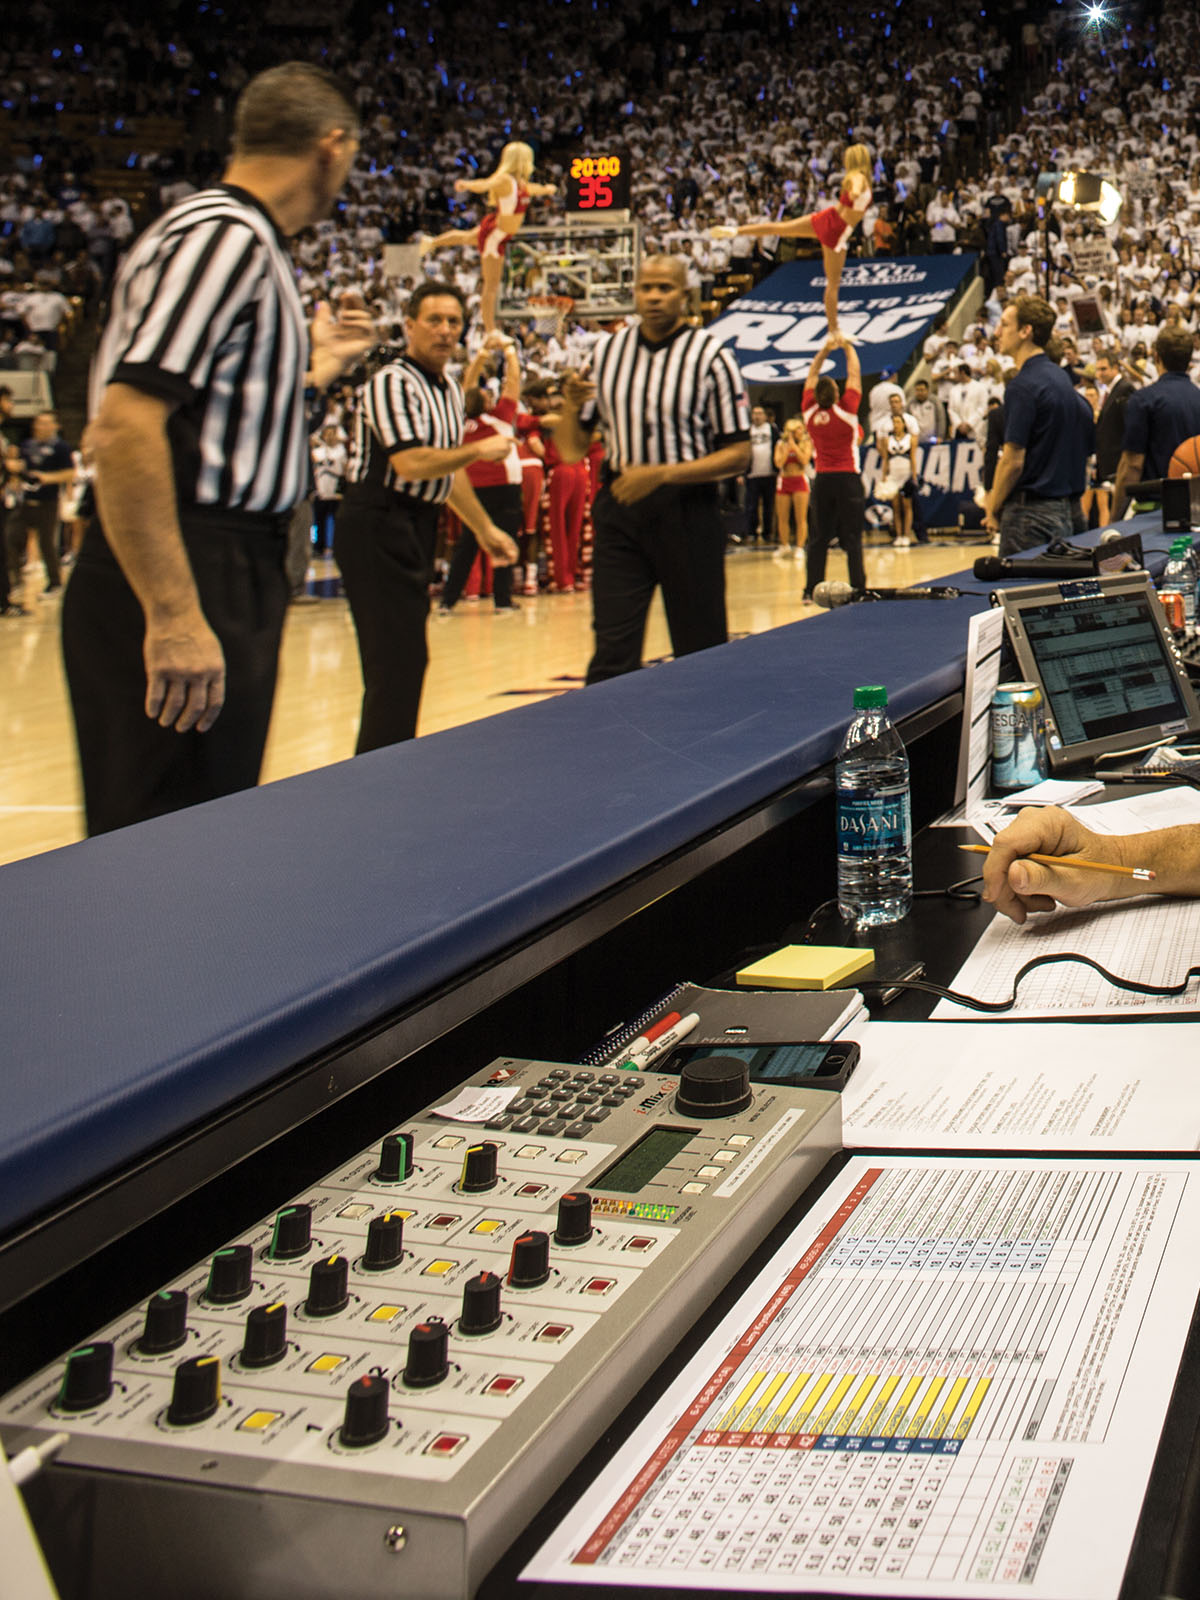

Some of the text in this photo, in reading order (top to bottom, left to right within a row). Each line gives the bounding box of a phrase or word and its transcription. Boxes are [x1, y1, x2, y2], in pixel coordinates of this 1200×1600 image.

[570, 156, 620, 179] 20:00
[578, 176, 613, 208] 35
[866, 296, 903, 310] TO
[705, 301, 946, 353] ROC
[861, 441, 985, 499] RAR
[841, 814, 897, 836] DASANI
[306, 1423, 323, 1433] 1
[703, 1432, 720, 1443] 55
[727, 1434, 743, 1444] 11
[750, 1434, 767, 1445] 25
[774, 1435, 790, 1446] 20
[799, 1436, 814, 1447] 42
[822, 1436, 838, 1448] 14
[846, 1438, 861, 1448] 31
[895, 1440, 910, 1450] 41
[943, 1440, 958, 1452] 35
